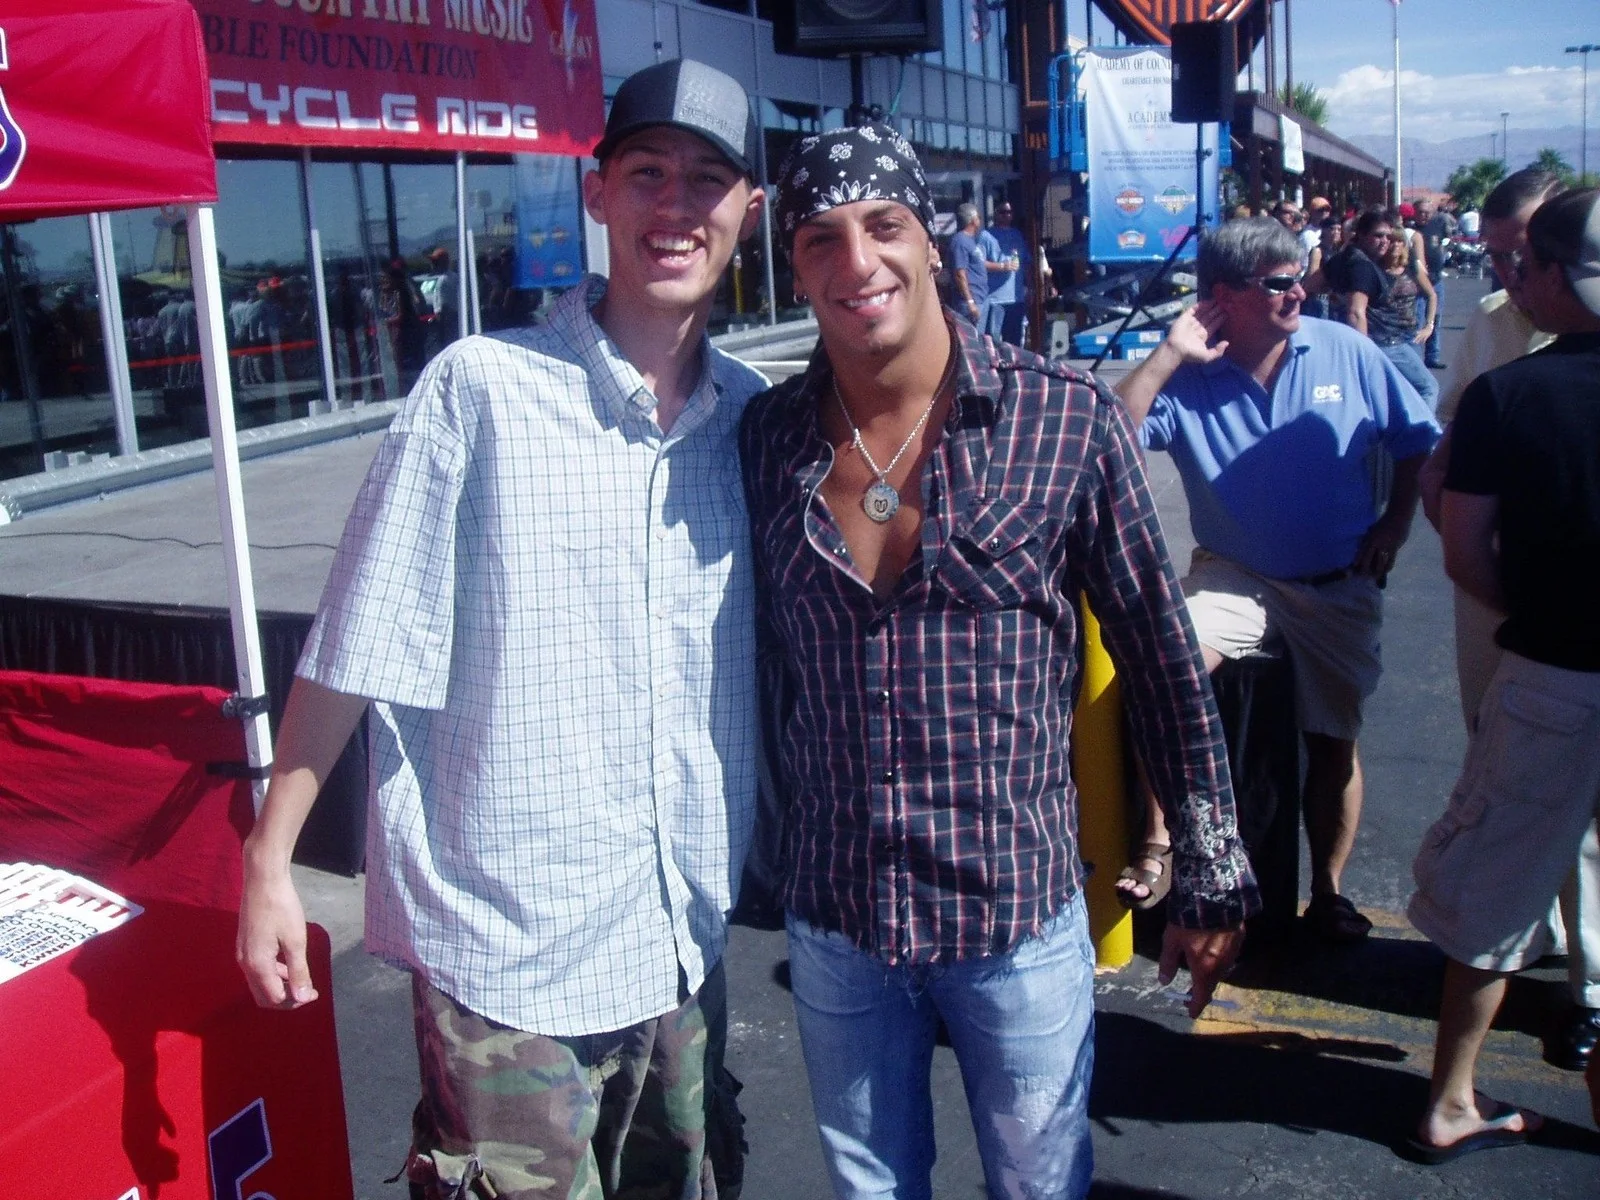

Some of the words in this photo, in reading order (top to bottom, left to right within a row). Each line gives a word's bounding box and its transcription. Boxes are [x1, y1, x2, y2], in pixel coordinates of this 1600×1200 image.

[278, 24, 478, 79] FOUNDATION
[210, 78, 420, 133] CYCLE
[437, 96, 539, 140] RIDE
